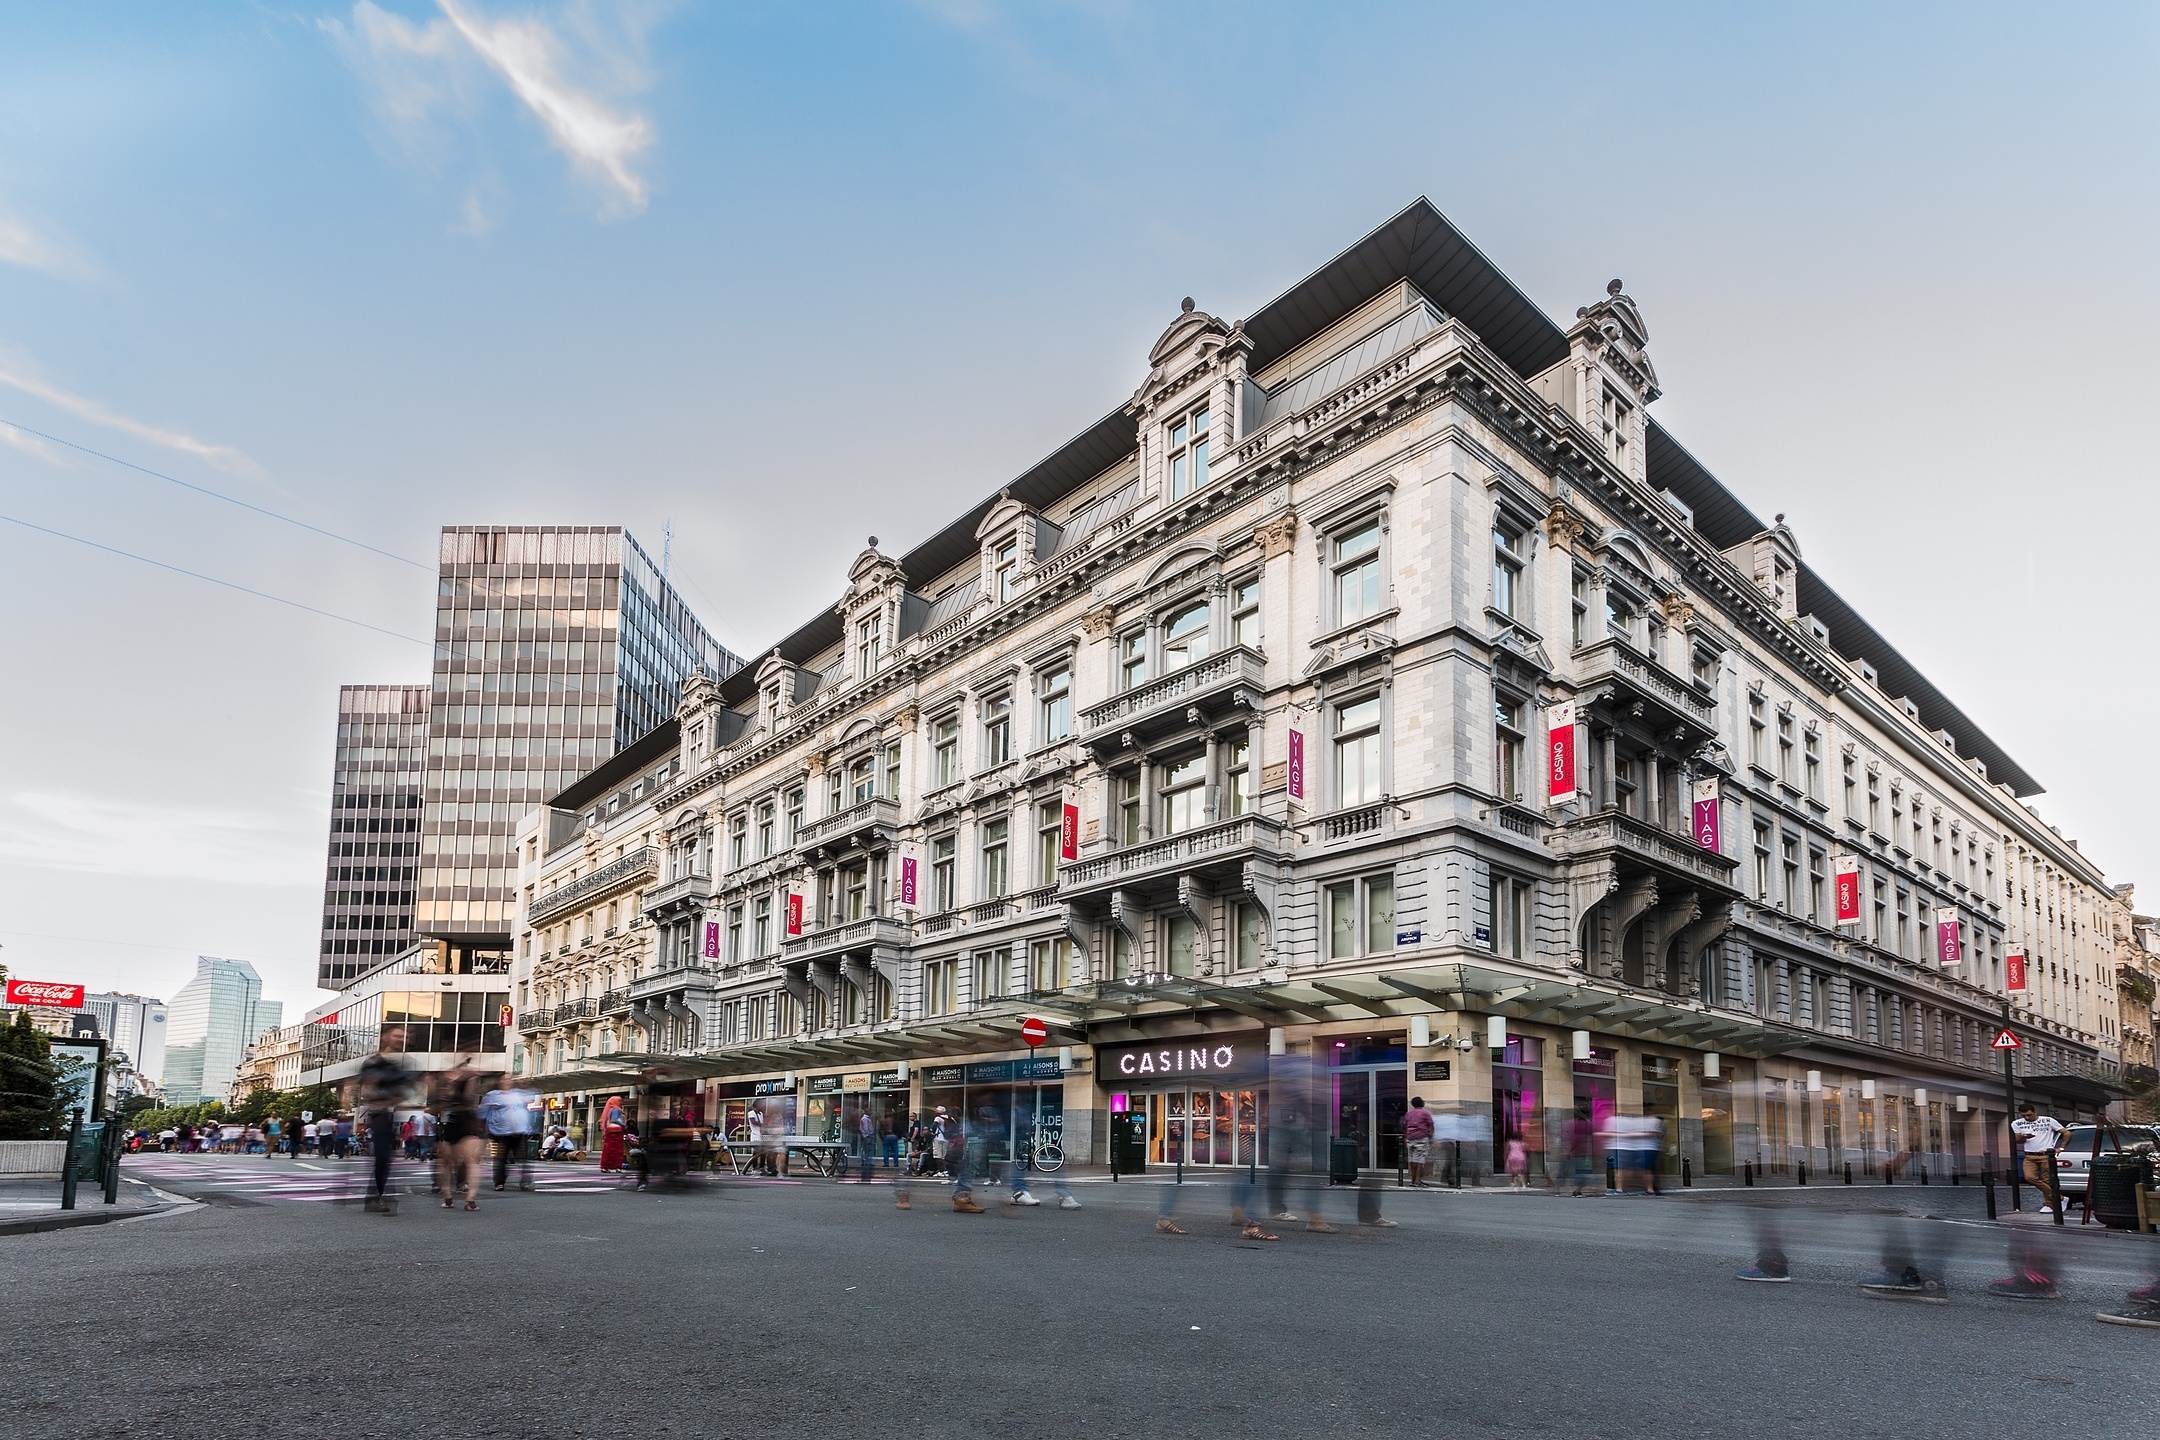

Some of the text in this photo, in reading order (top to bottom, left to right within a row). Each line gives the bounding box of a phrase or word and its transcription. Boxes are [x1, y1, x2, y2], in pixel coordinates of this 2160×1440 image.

[1292, 732, 1300, 796] VIAGE
[1554, 741, 1564, 781] CASINO
[1553, 793, 1573, 802] VIAGE
[1064, 815, 1072, 847] CASINO
[1700, 801, 1713, 849] VIAG
[905, 859, 913, 903] VIAGE
[1840, 883, 1850, 910] CASINO
[708, 923, 716, 957] VIAGE
[1944, 923, 1955, 960] VIAGE
[2009, 962, 2018, 983] CASINO
[13, 982, 78, 1000] Coca-Cola
[978, 1065, 1001, 1073] MAISONS
[1120, 1045, 1234, 1074] CASINO
